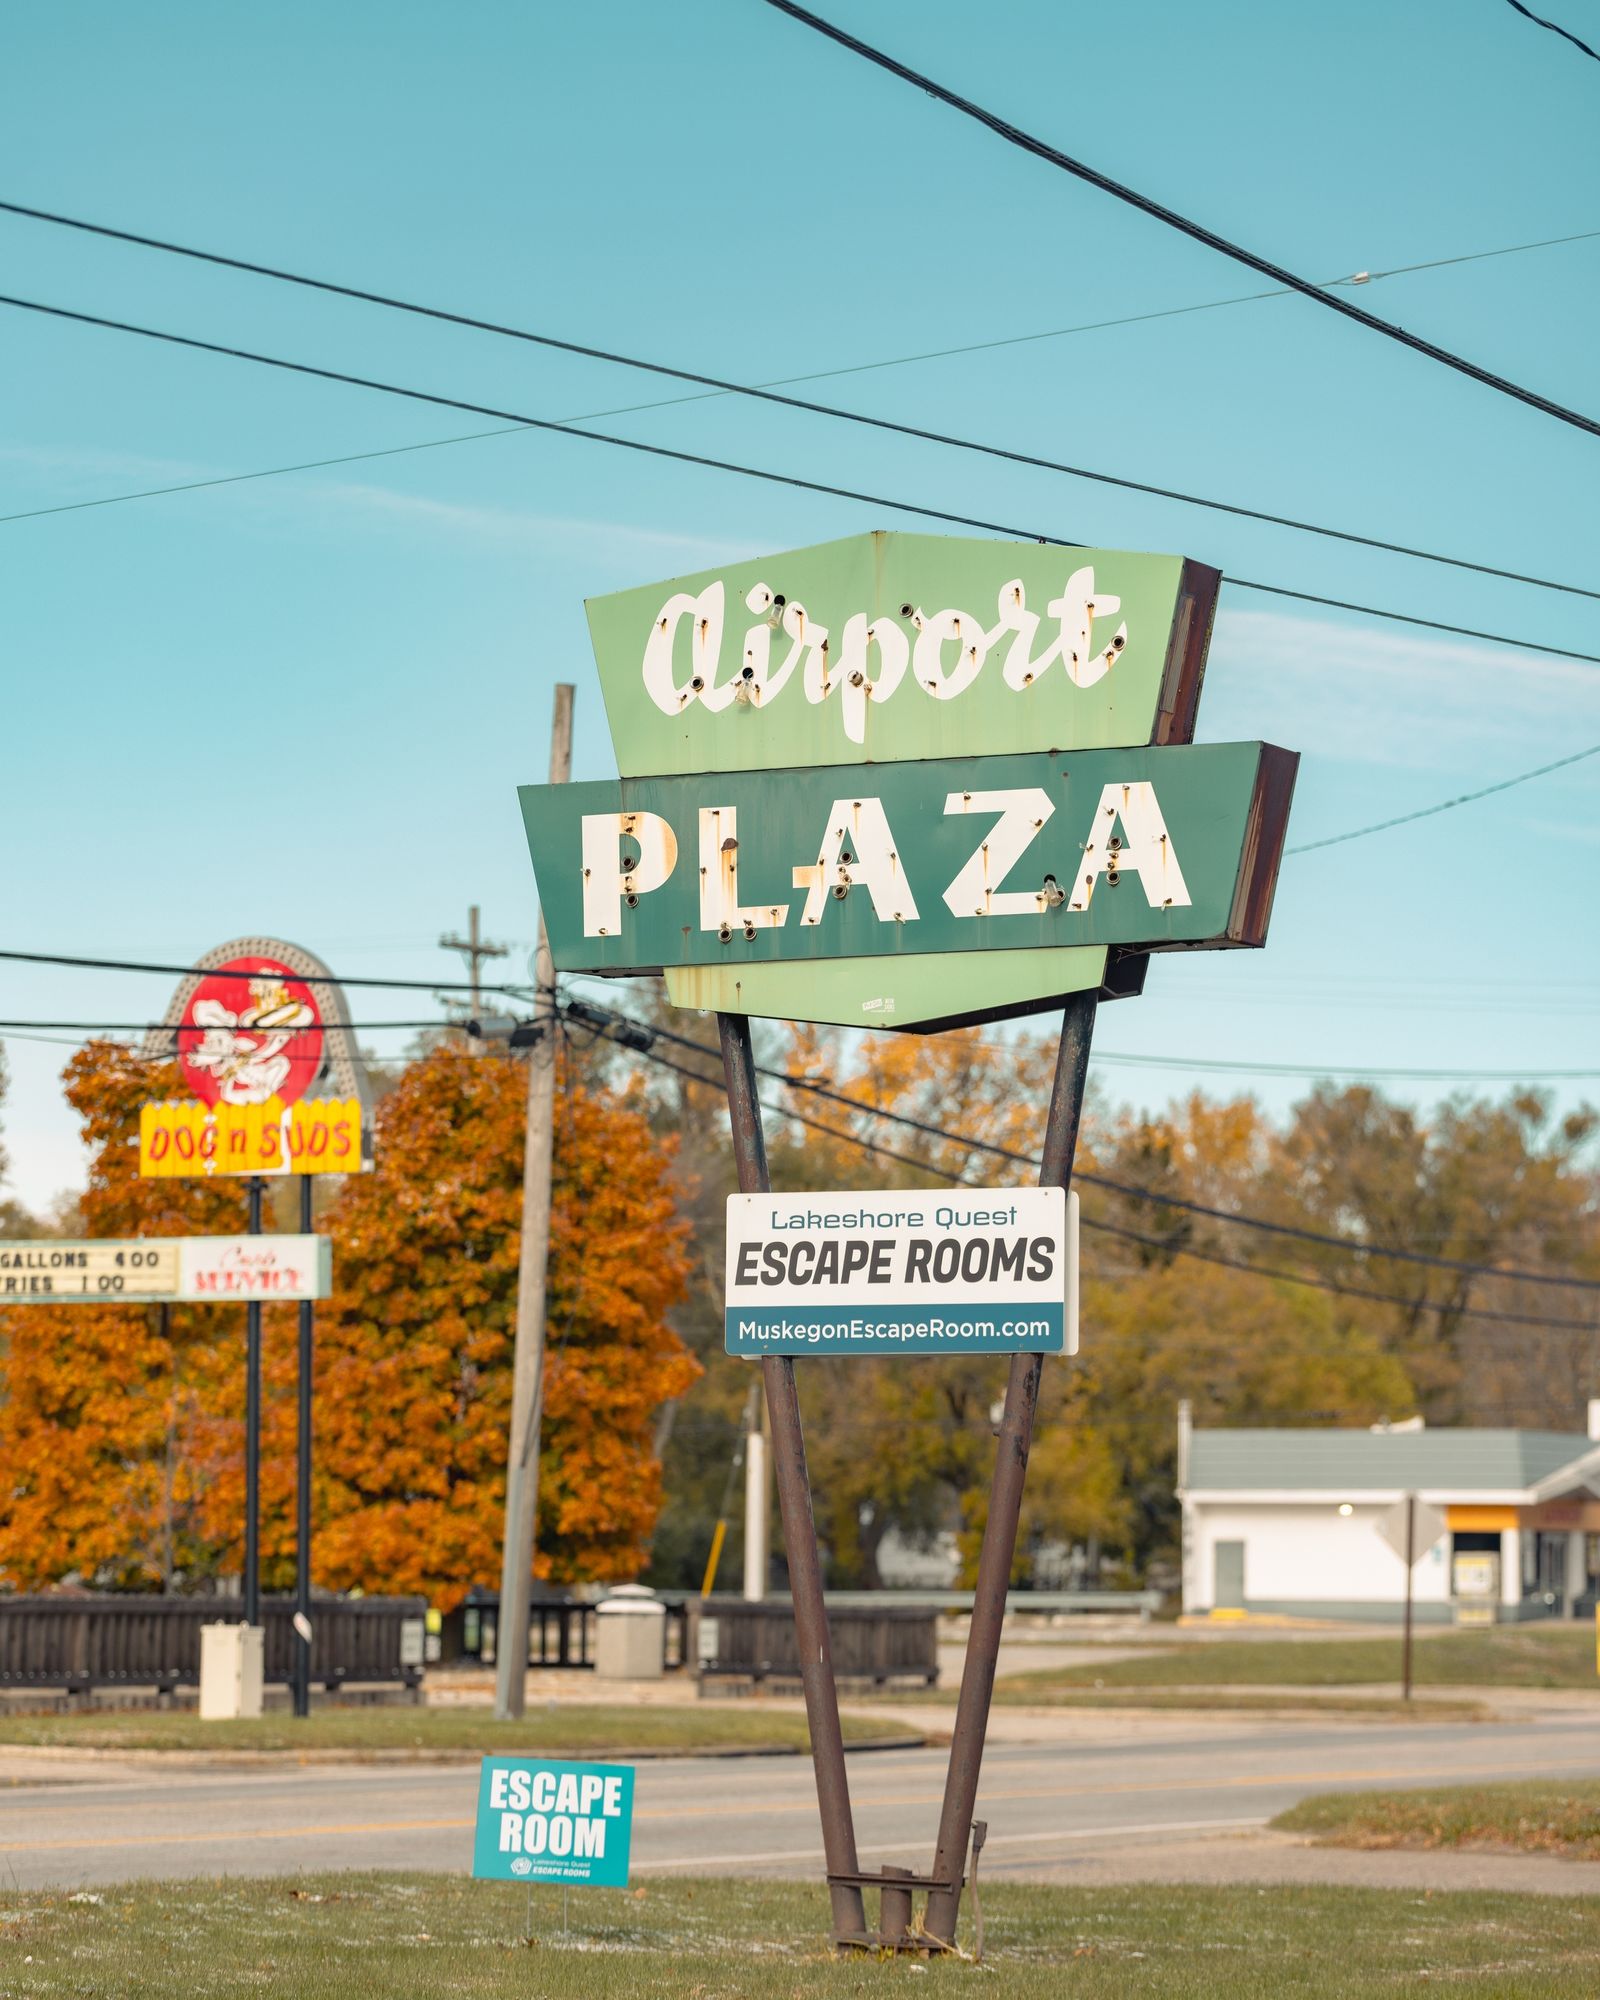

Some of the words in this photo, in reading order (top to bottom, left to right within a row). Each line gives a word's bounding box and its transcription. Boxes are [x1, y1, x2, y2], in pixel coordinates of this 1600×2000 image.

[581, 780, 1193, 938] PLAZA
[149, 1123, 218, 1161] DOG
[258, 1120, 352, 1158] SUDS
[771, 1209, 925, 1230] Lakeshore
[934, 1205, 1018, 1231] Quest
[0, 1252, 88, 1268] GALLONS
[734, 1239, 897, 1287] ESCAPE
[903, 1235, 1056, 1285] ROOMS
[0, 1276, 52, 1292] RIES
[738, 1318, 1051, 1343] MuskegonEscapeRoom.com
[490, 1768, 622, 1817] ESCAPE
[498, 1812, 607, 1859] ROOM
